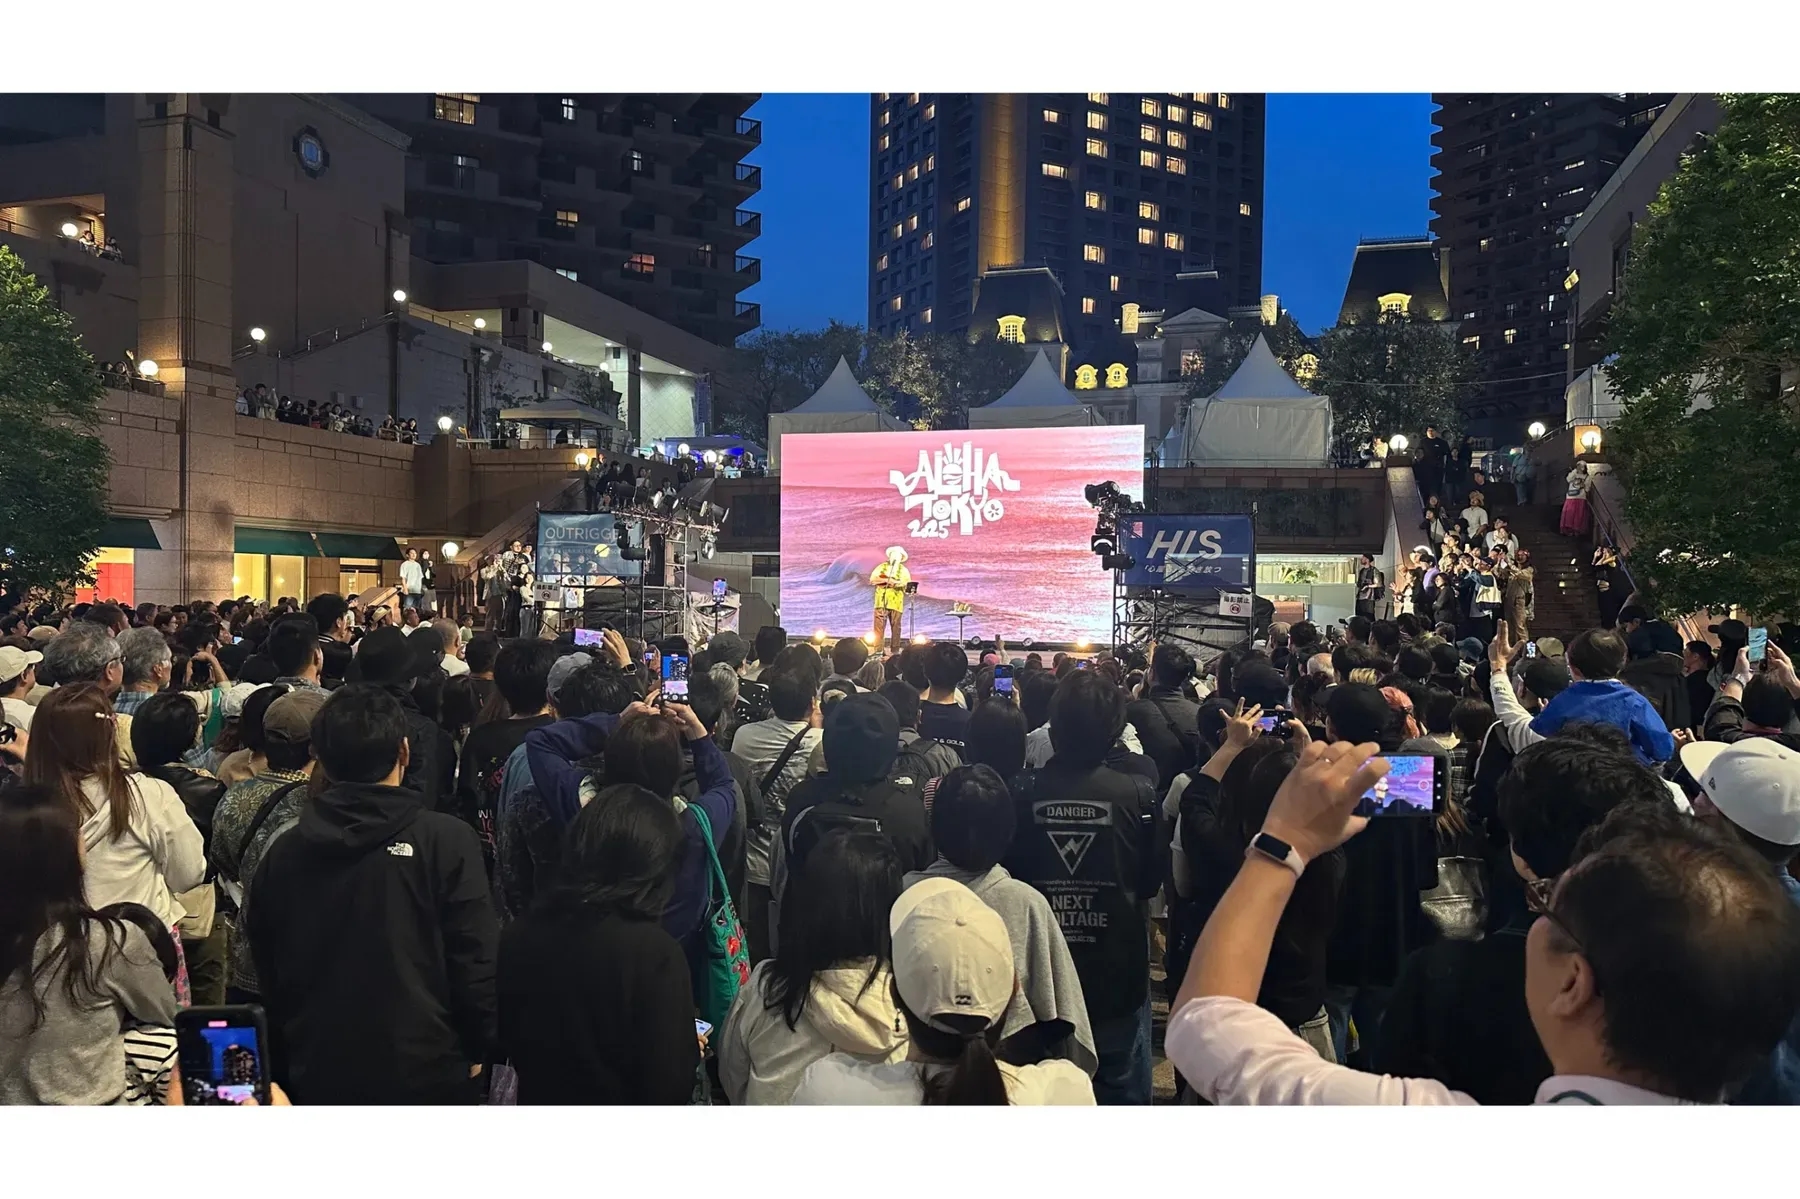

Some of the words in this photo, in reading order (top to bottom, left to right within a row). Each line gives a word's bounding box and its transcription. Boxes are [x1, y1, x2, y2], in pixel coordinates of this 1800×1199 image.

[890, 441, 1020, 496] ALOHA
[905, 489, 1004, 535] TOKYO
[545, 526, 619, 540] OUTRIGGE
[1146, 530, 1222, 559] HIS
[1046, 806, 1096, 817] DANGER
[1052, 894, 1093, 910] NEXT
